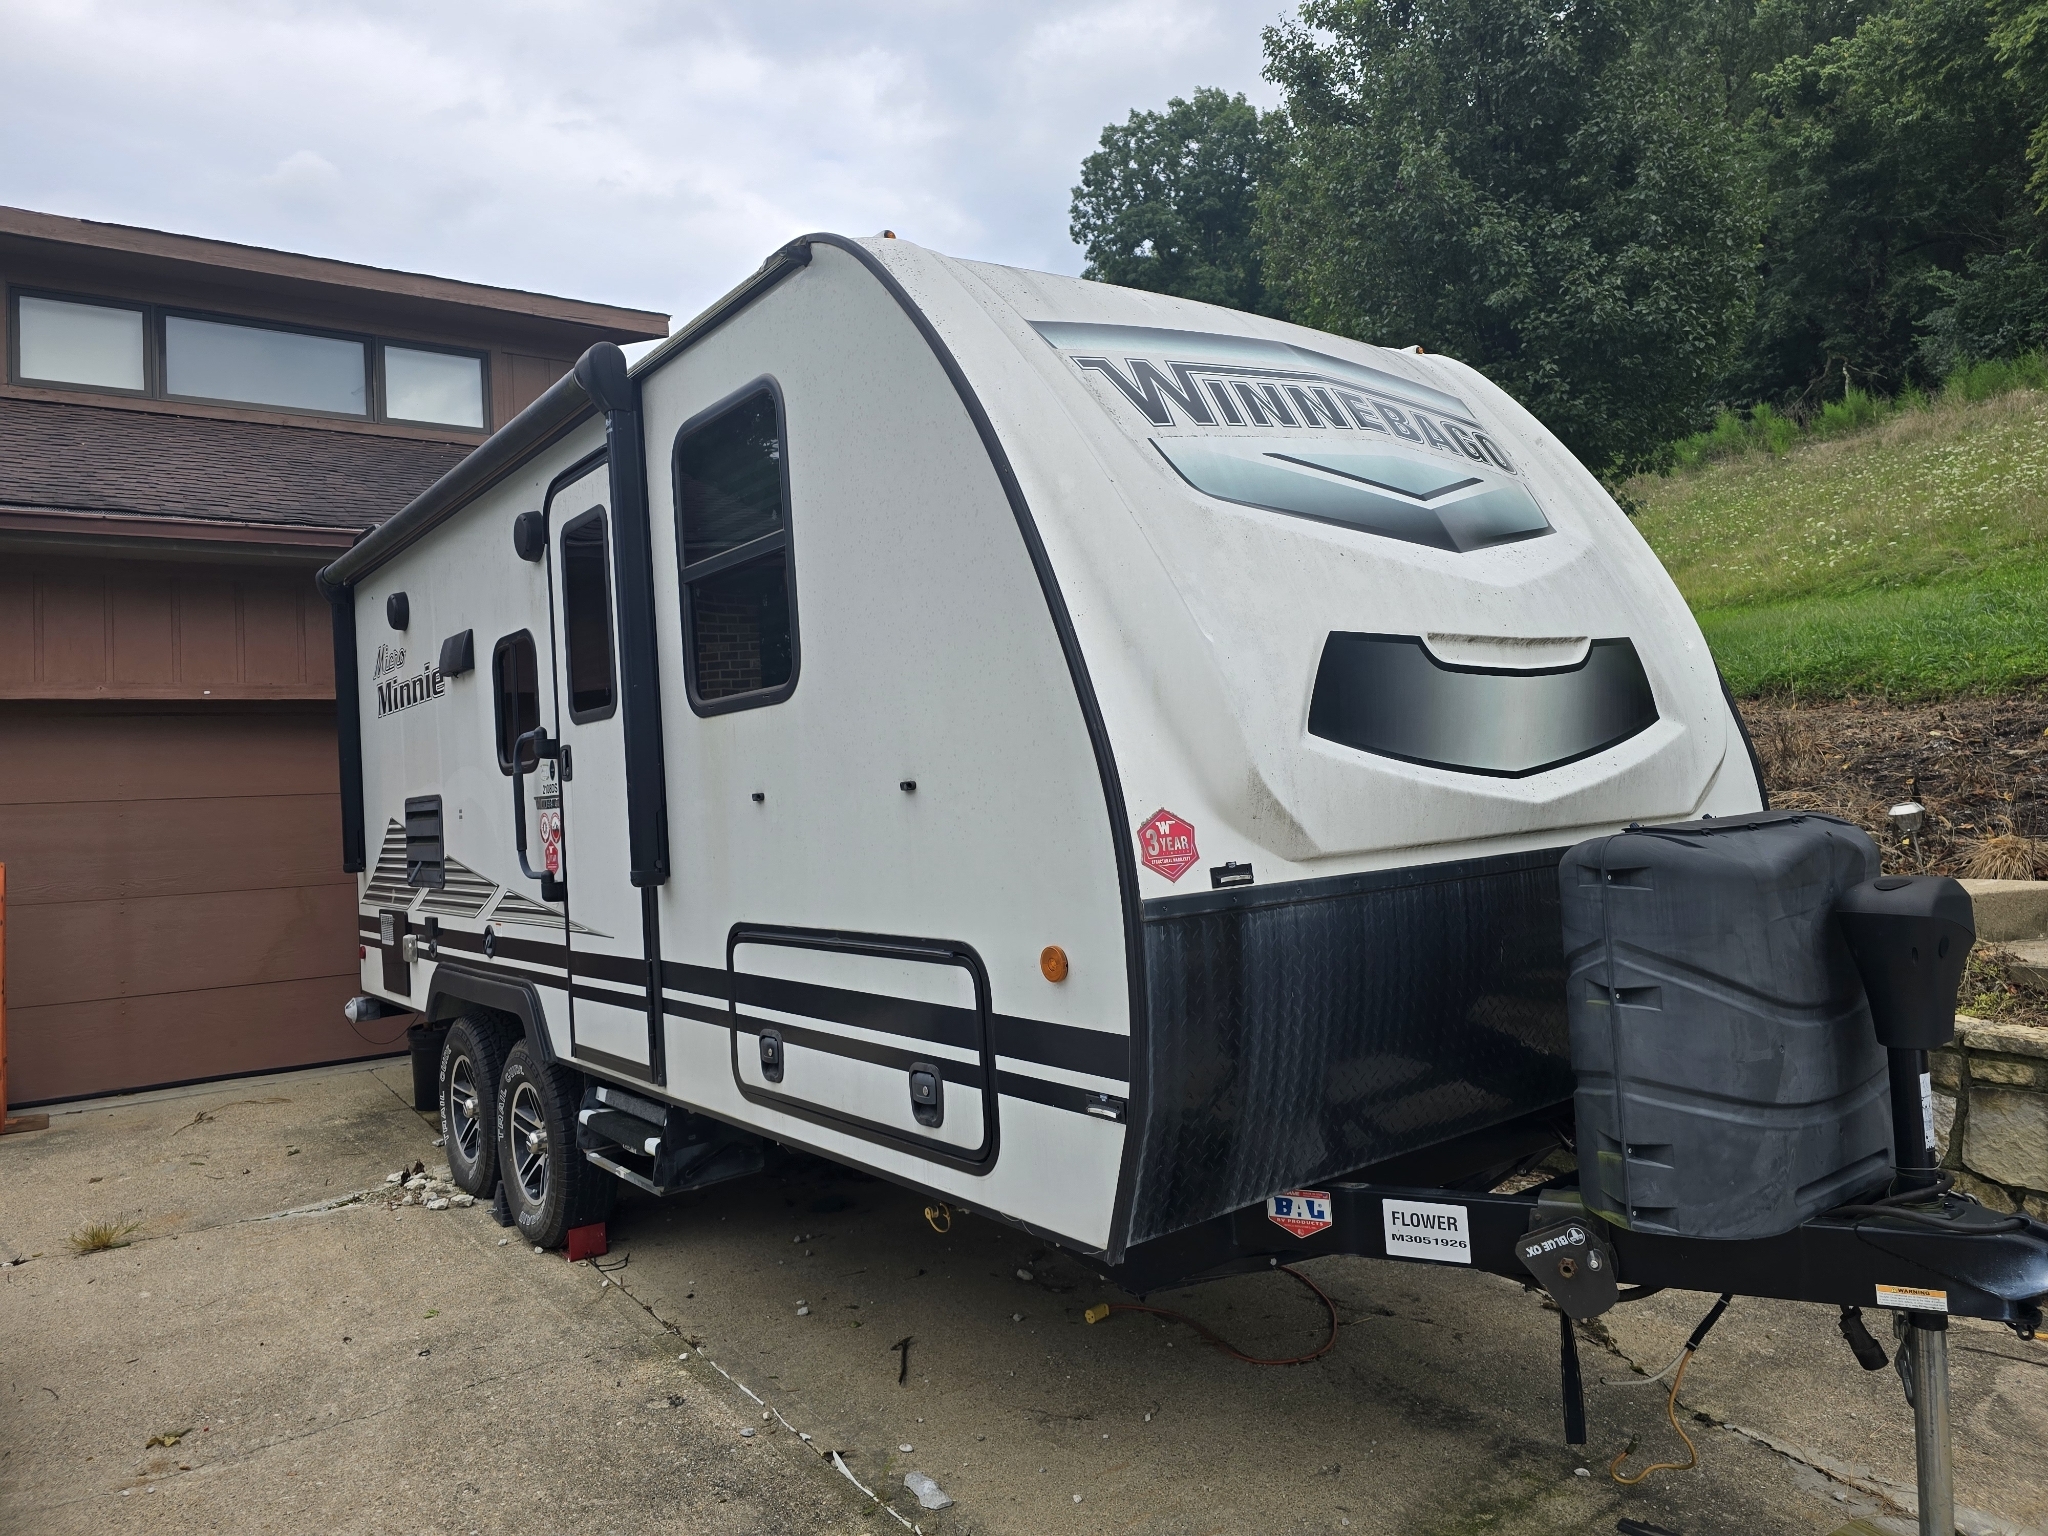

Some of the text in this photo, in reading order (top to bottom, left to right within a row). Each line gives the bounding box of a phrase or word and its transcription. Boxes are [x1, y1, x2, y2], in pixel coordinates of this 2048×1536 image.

[1069, 355, 1518, 476] WINNEBAGO
[373, 644, 406, 680] Micro
[376, 661, 445, 719] Minnie
[1145, 829, 1189, 856] 3 YEAR
[497, 1088, 507, 1142] TRAIL
[1274, 1196, 1325, 1219] BAL
[1391, 1210, 1459, 1232] FLOWER
[1391, 1233, 1468, 1249] M3051926
[1525, 1234, 1569, 1258] BLUE OX
[1897, 1288, 1931, 1296] WARNING
